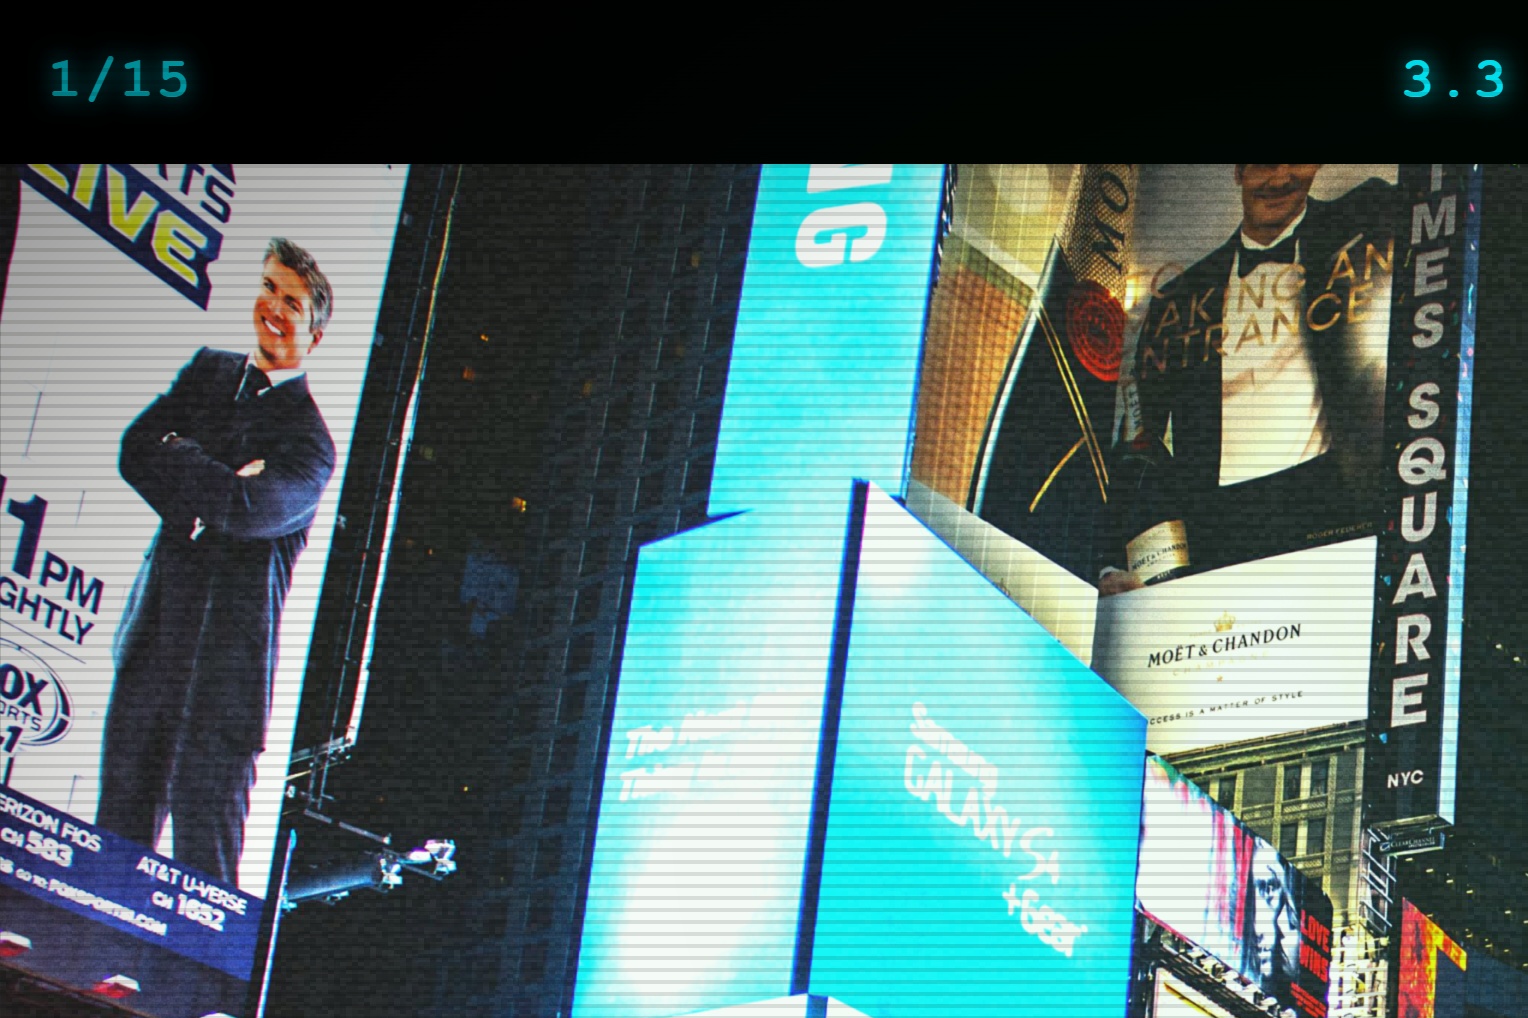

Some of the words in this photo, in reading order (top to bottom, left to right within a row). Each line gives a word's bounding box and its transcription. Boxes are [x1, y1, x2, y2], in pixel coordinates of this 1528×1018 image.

[1390, 382, 1447, 729] SQUARE
[1147, 643, 1196, 668] MOËT
[1197, 644, 1208, 657] &
[1212, 623, 1303, 655] CHANDON
[1184, 711, 1195, 719] IS
[1209, 700, 1249, 713] MATTER
[1254, 696, 1267, 706] OF
[1271, 690, 1304, 702] STYLE
[1387, 769, 1424, 789] NYC
[0, 827, 25, 848] CH
[25, 830, 74, 868] 583
[136, 856, 182, 885] AT&T
[182, 872, 248, 915] U-VERSE
[152, 890, 174, 910] CH
